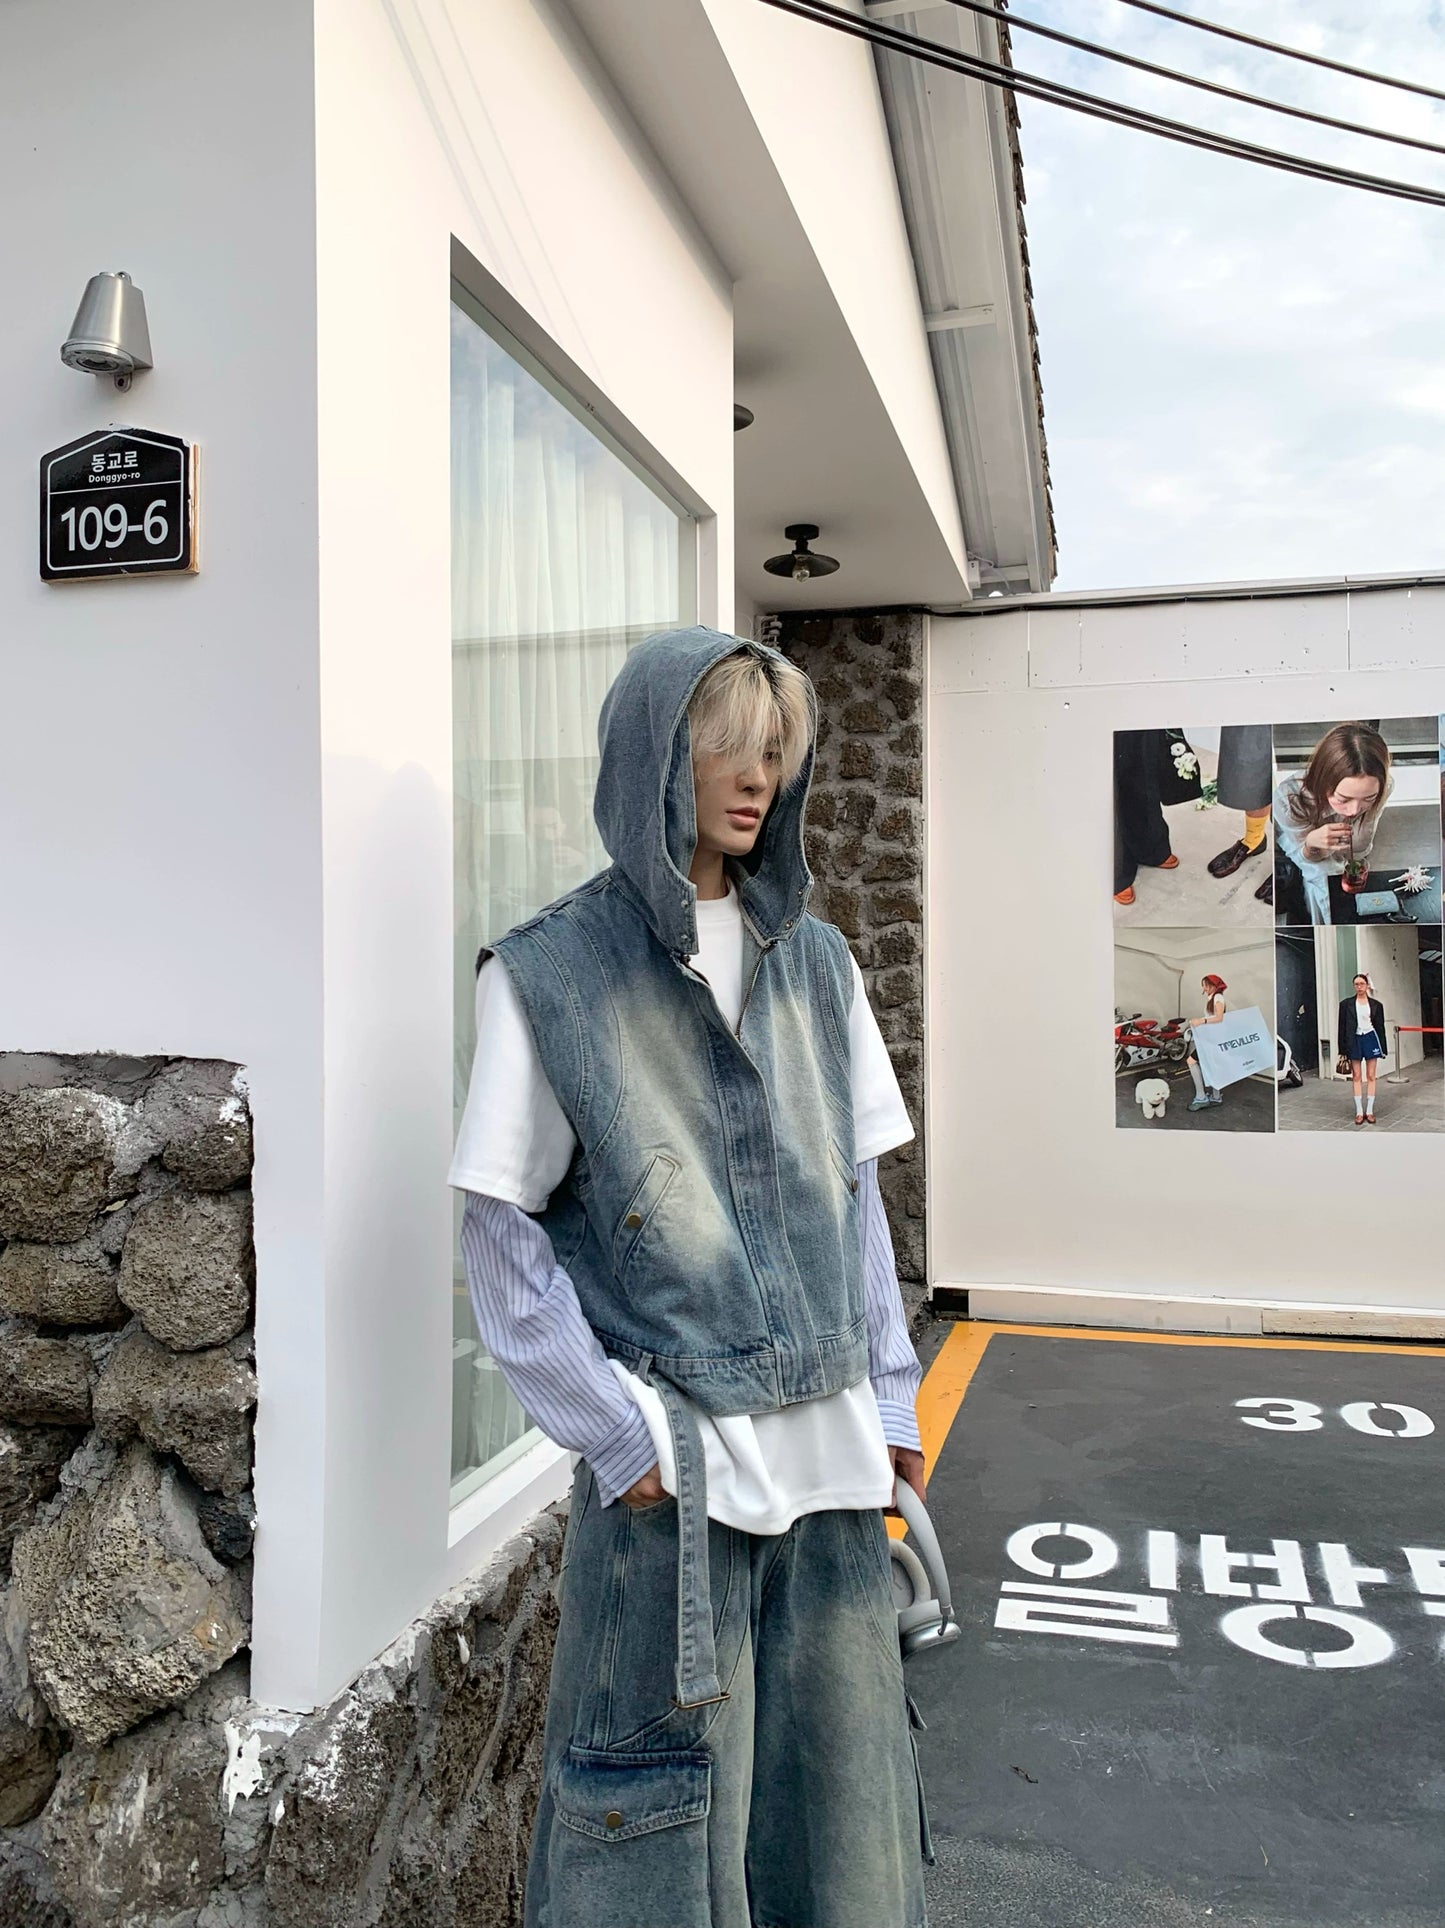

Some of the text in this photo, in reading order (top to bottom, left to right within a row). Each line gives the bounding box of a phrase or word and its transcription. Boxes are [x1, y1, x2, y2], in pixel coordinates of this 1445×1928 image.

[88, 471, 141, 484] Donggyo-ro
[91, 450, 139, 473] 동교로
[60, 499, 169, 551] 109-6
[1234, 1397, 1436, 1438] 30
[994, 1522, 1445, 1669] 일방
